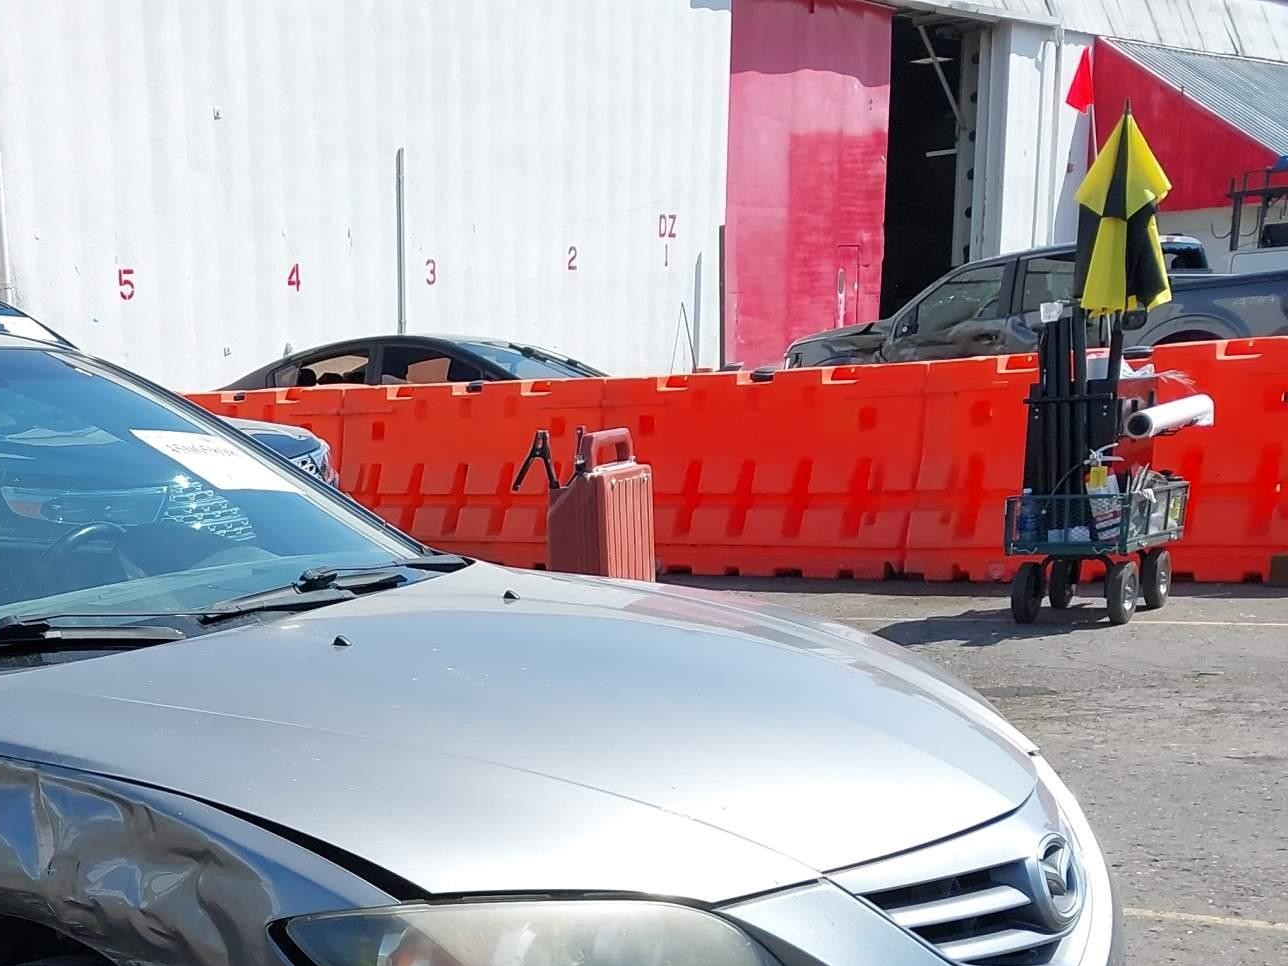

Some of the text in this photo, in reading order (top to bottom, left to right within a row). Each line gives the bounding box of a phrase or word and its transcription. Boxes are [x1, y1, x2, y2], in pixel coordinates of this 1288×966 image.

[658, 213, 677, 238] DZ
[567, 246, 577, 270] 2
[118, 269, 135, 300] 5
[287, 263, 301, 292] 4
[425, 259, 436, 285] 3
